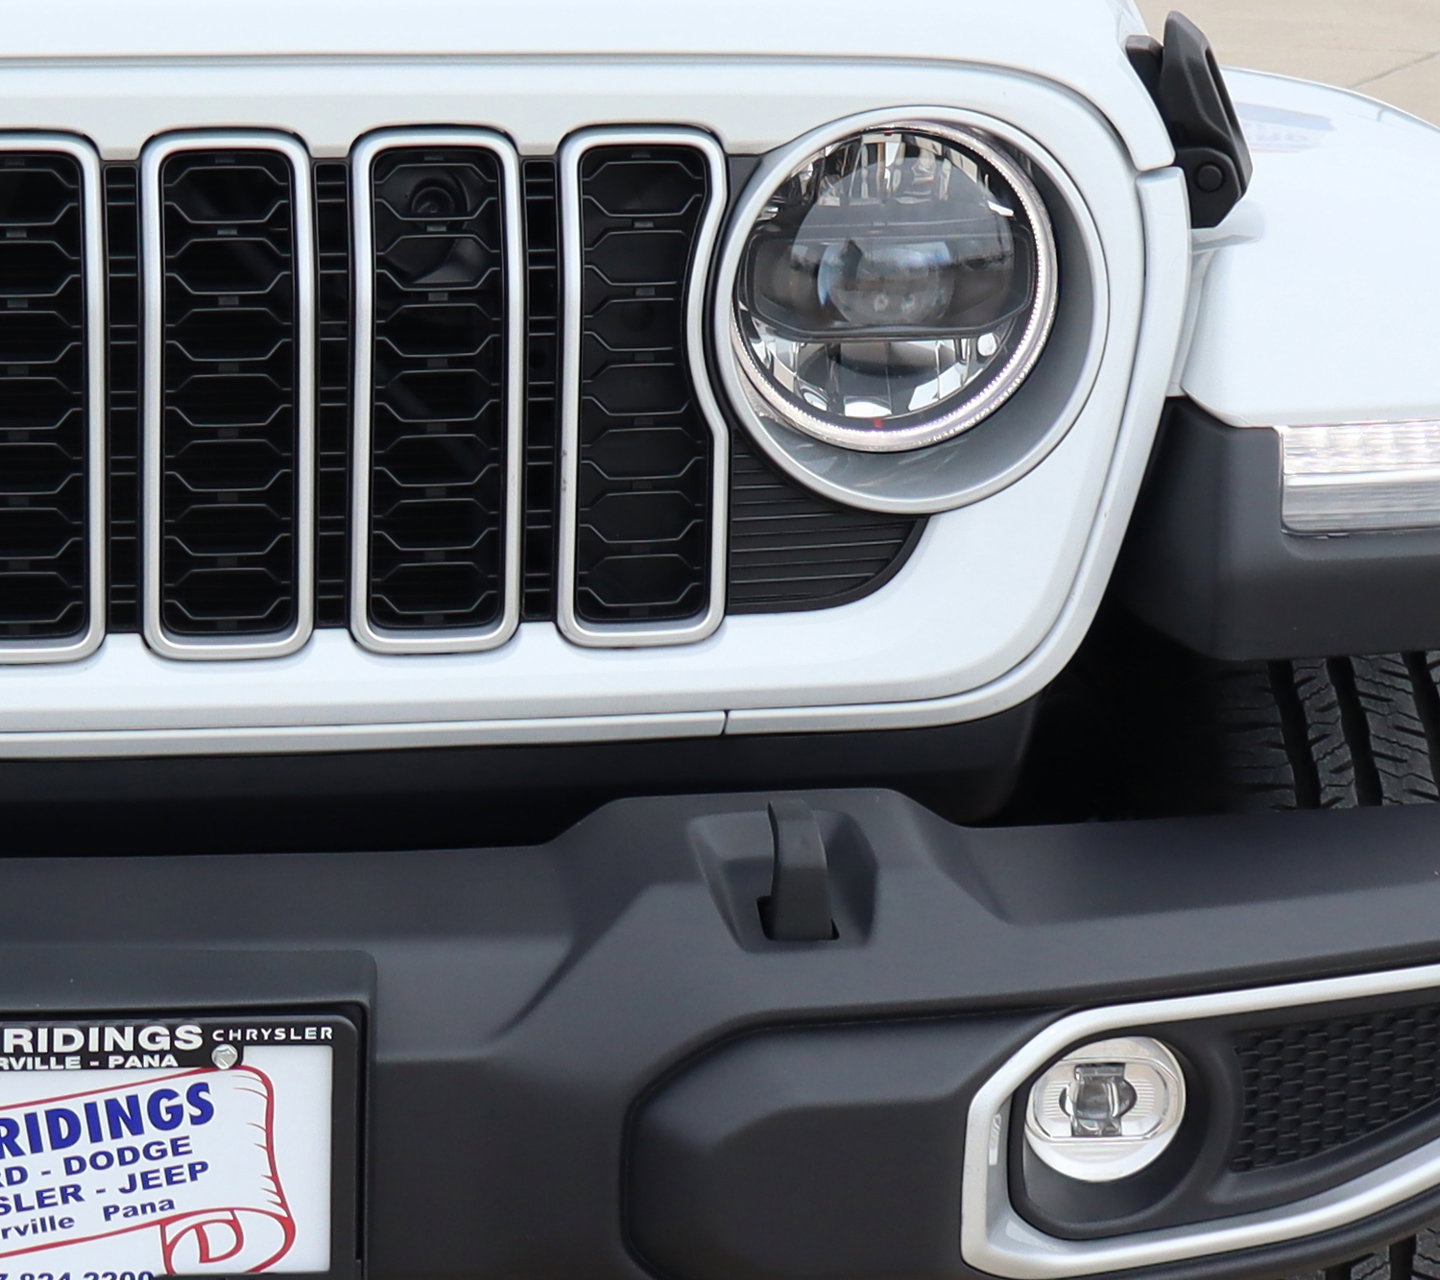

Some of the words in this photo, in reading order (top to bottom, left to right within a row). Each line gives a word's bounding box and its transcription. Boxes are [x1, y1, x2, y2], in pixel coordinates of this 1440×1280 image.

[3, 1025, 203, 1054] RIDINGS
[212, 1027, 333, 1042] CHRYSLER
[108, 1054, 179, 1068] PANA
[63, 1135, 193, 1176] DODGE
[118, 1161, 210, 1195] JEEP
[103, 1198, 175, 1221] Pana
